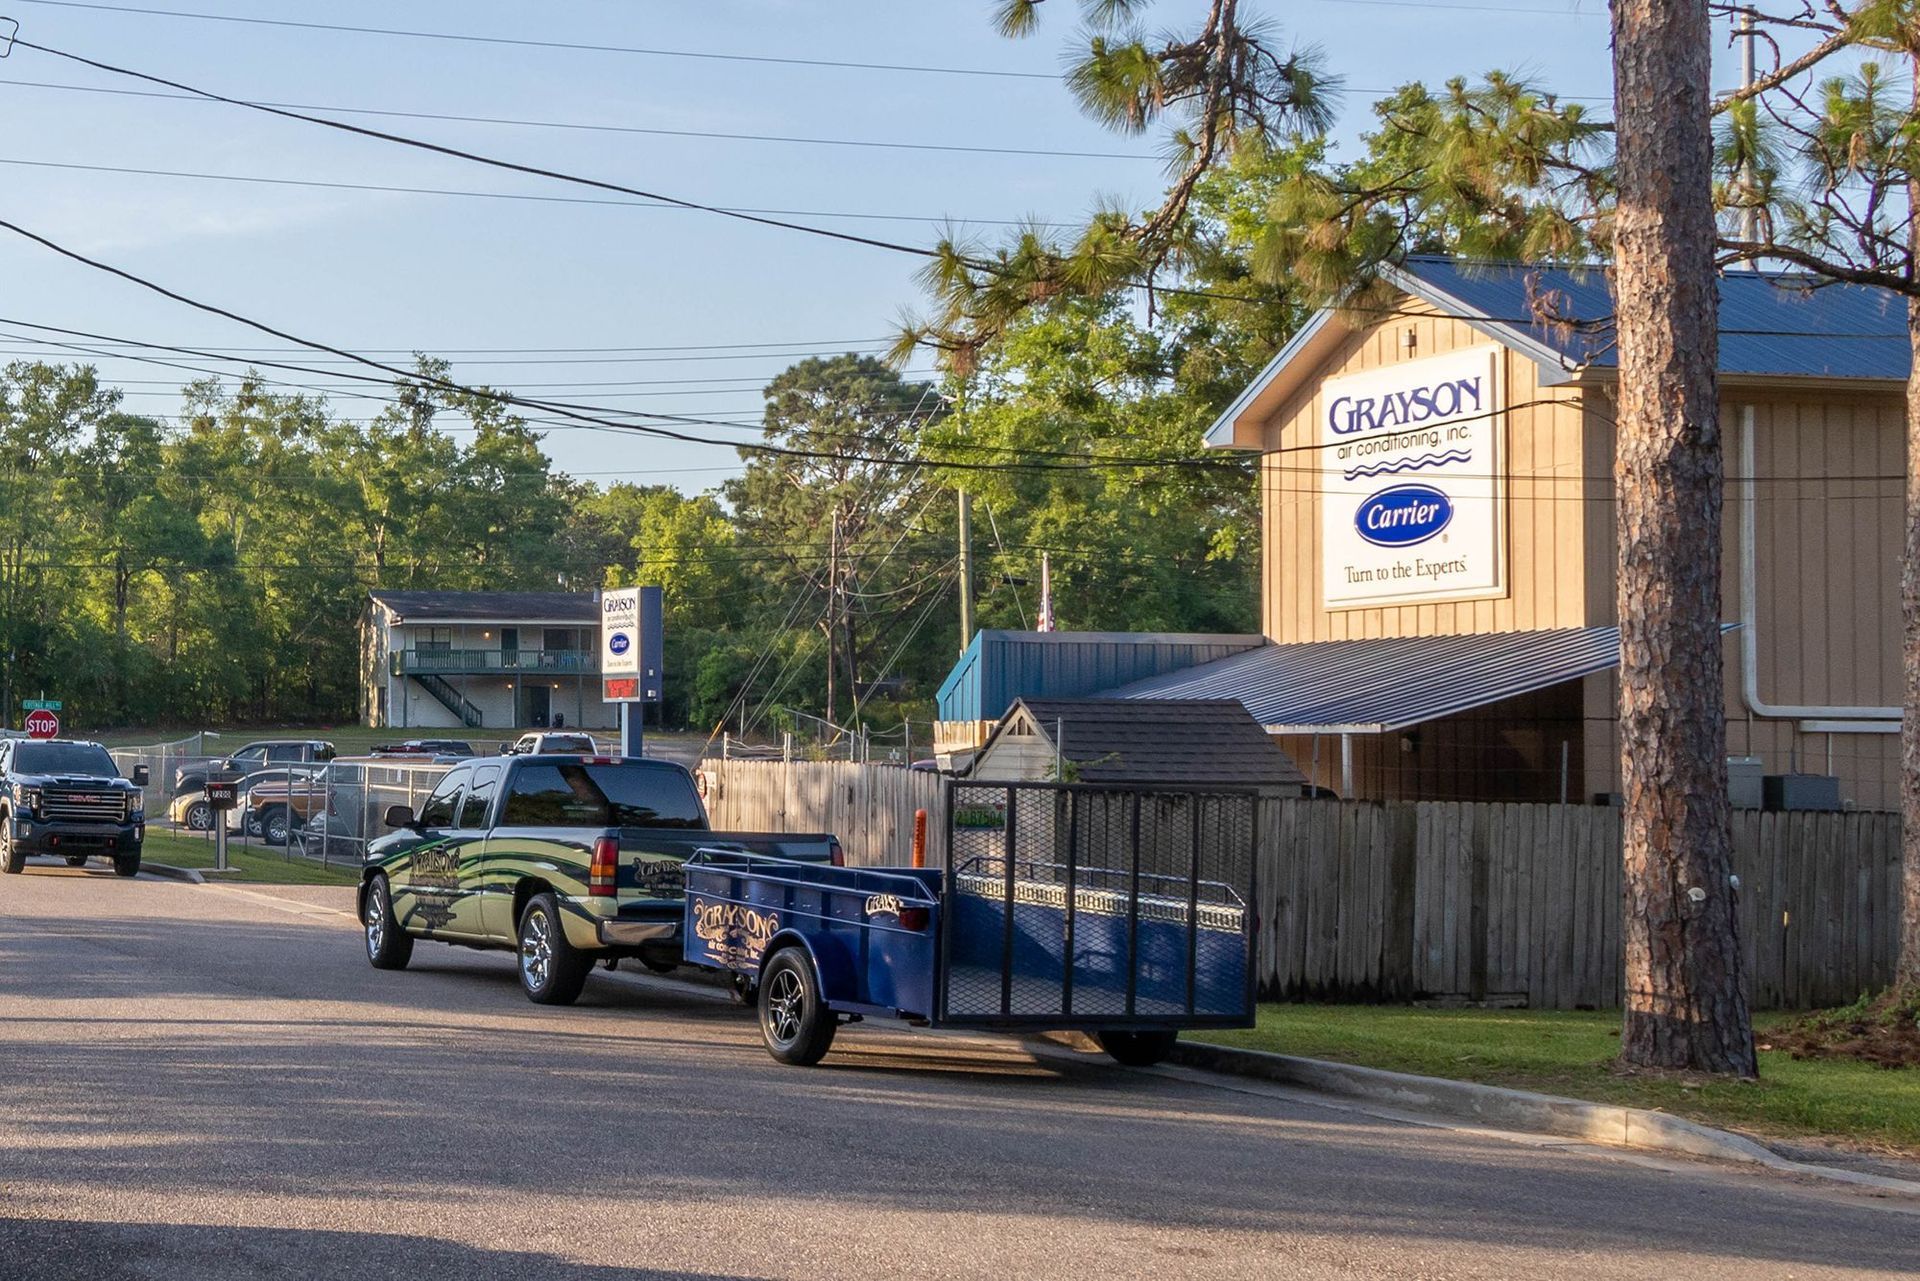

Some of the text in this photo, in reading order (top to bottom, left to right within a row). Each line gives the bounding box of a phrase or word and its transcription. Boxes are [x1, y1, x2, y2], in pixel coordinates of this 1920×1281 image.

[1329, 377, 1481, 435] GRAYSON
[1337, 425, 1472, 460] air conditioning, inc.
[1367, 500, 1439, 530] Carrier
[1344, 566, 1373, 583] Turn
[1377, 567, 1389, 580] to
[1392, 561, 1412, 579] the
[604, 597, 636, 613] GRAYSON
[28, 720, 56, 733] STOP
[704, 905, 767, 943] GRAYSON
